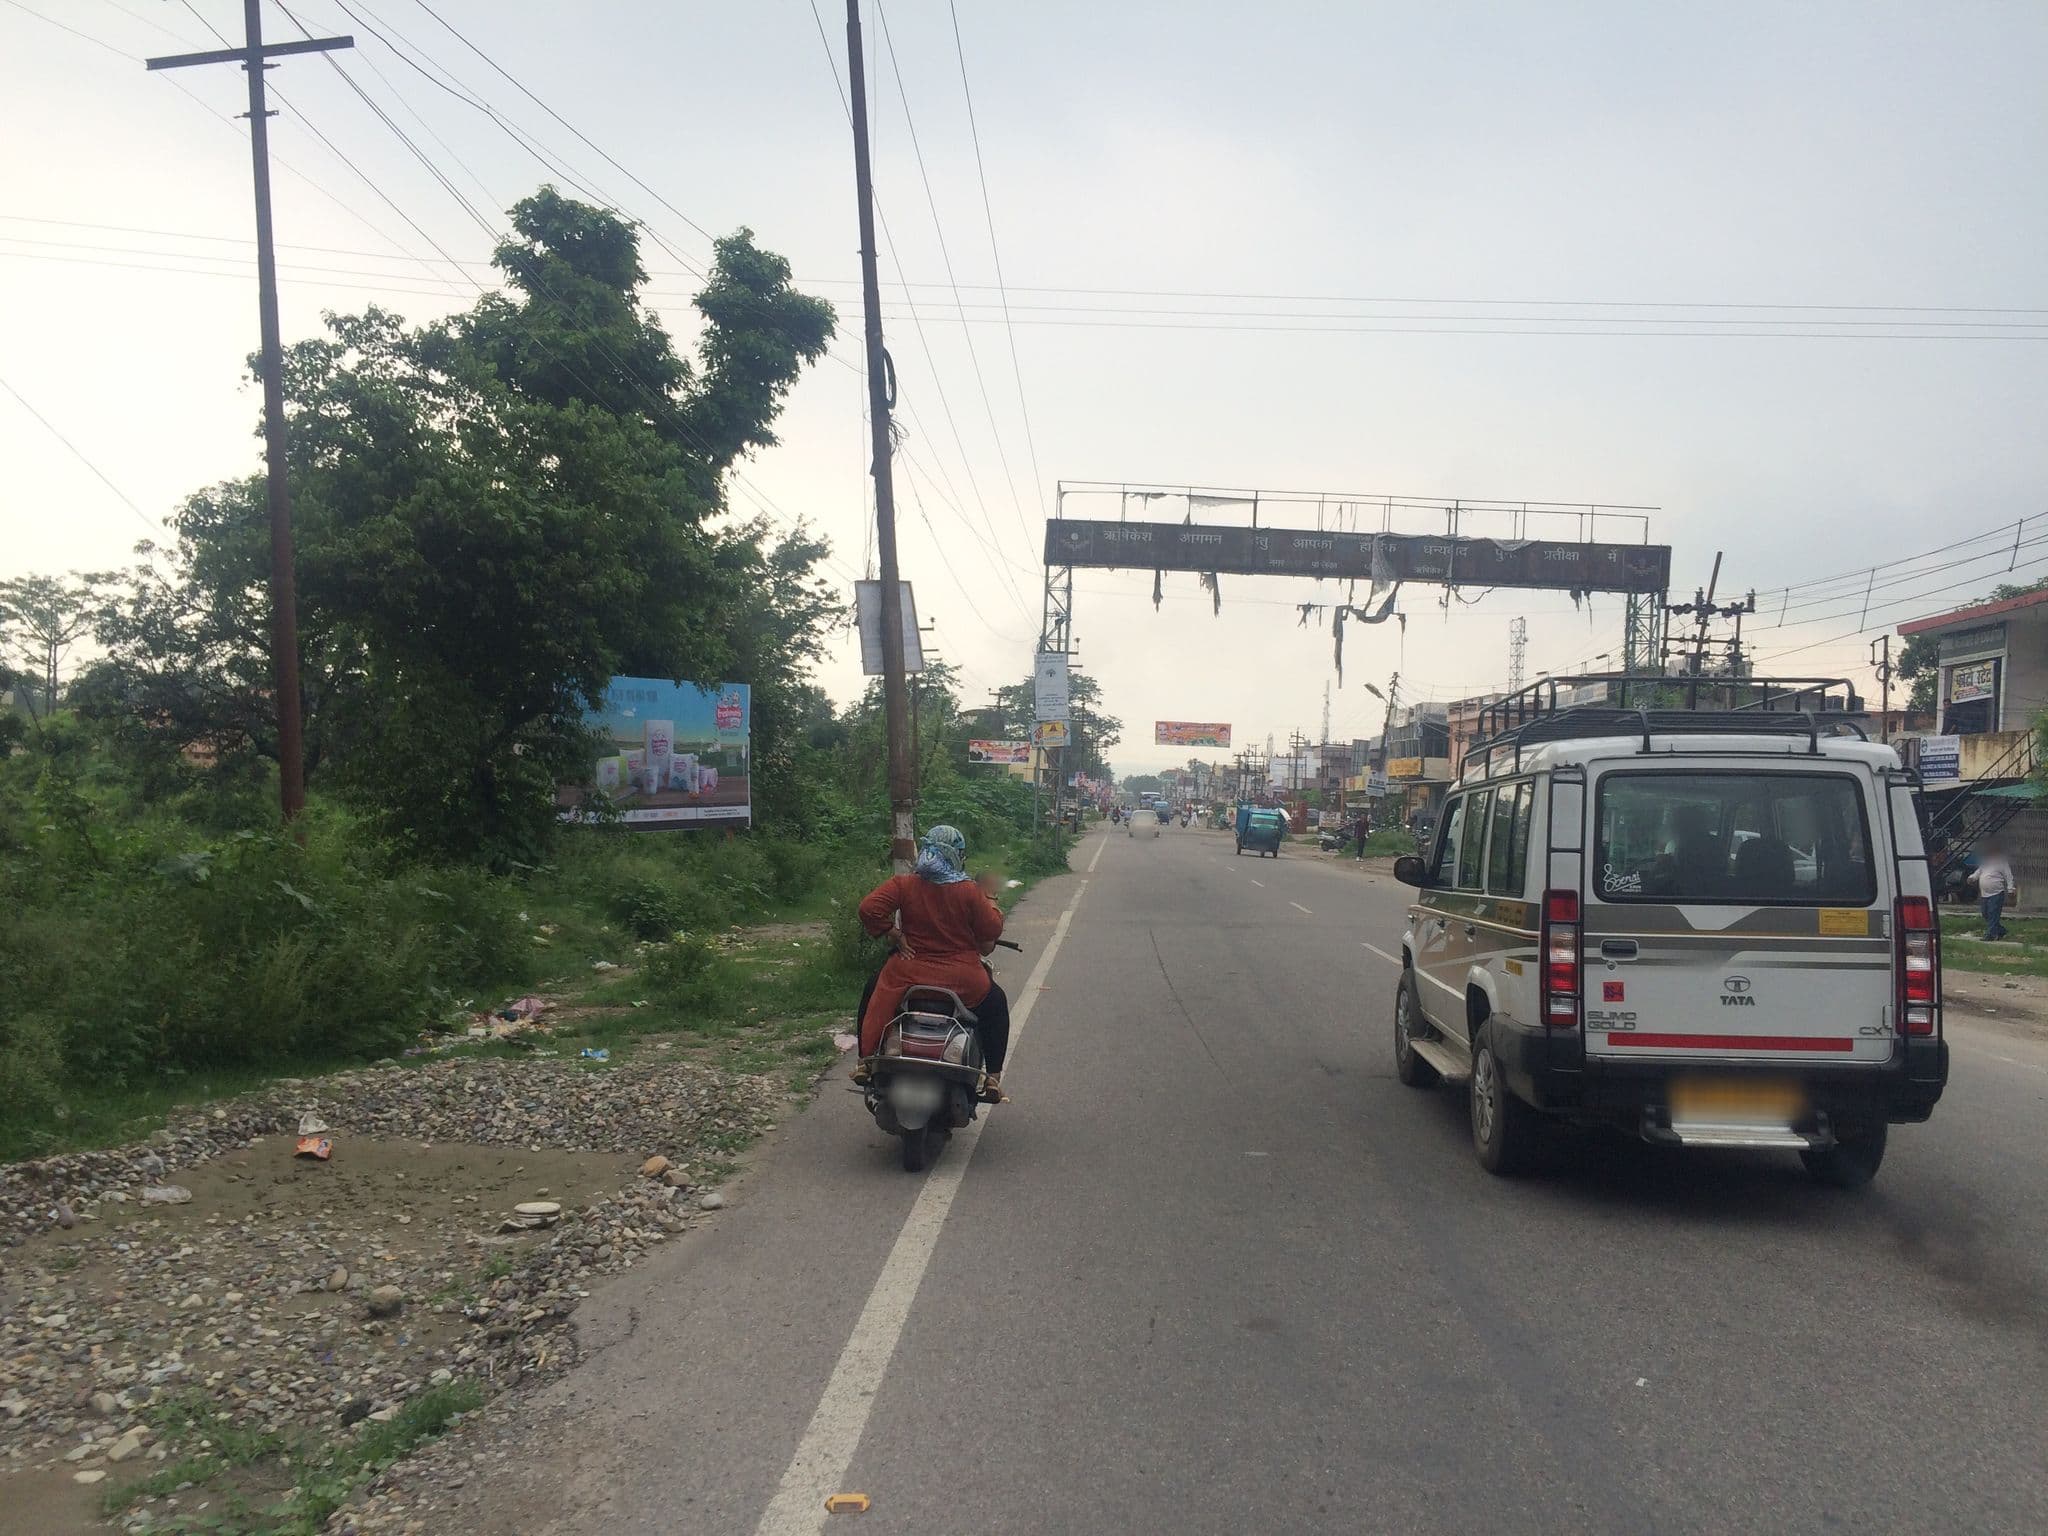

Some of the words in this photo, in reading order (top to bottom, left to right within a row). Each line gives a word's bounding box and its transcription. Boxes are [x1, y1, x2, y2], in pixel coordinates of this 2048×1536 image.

[1103, 527, 1153, 542] ऋषिकेश
[1179, 531, 1223, 545] आगमन
[1292, 537, 1333, 550] आपका
[1719, 995, 1756, 1006] TATA
[1587, 1010, 1637, 1021] SUMO
[1587, 1020, 1637, 1031] GOLD
[1859, 1026, 1883, 1036] CX
